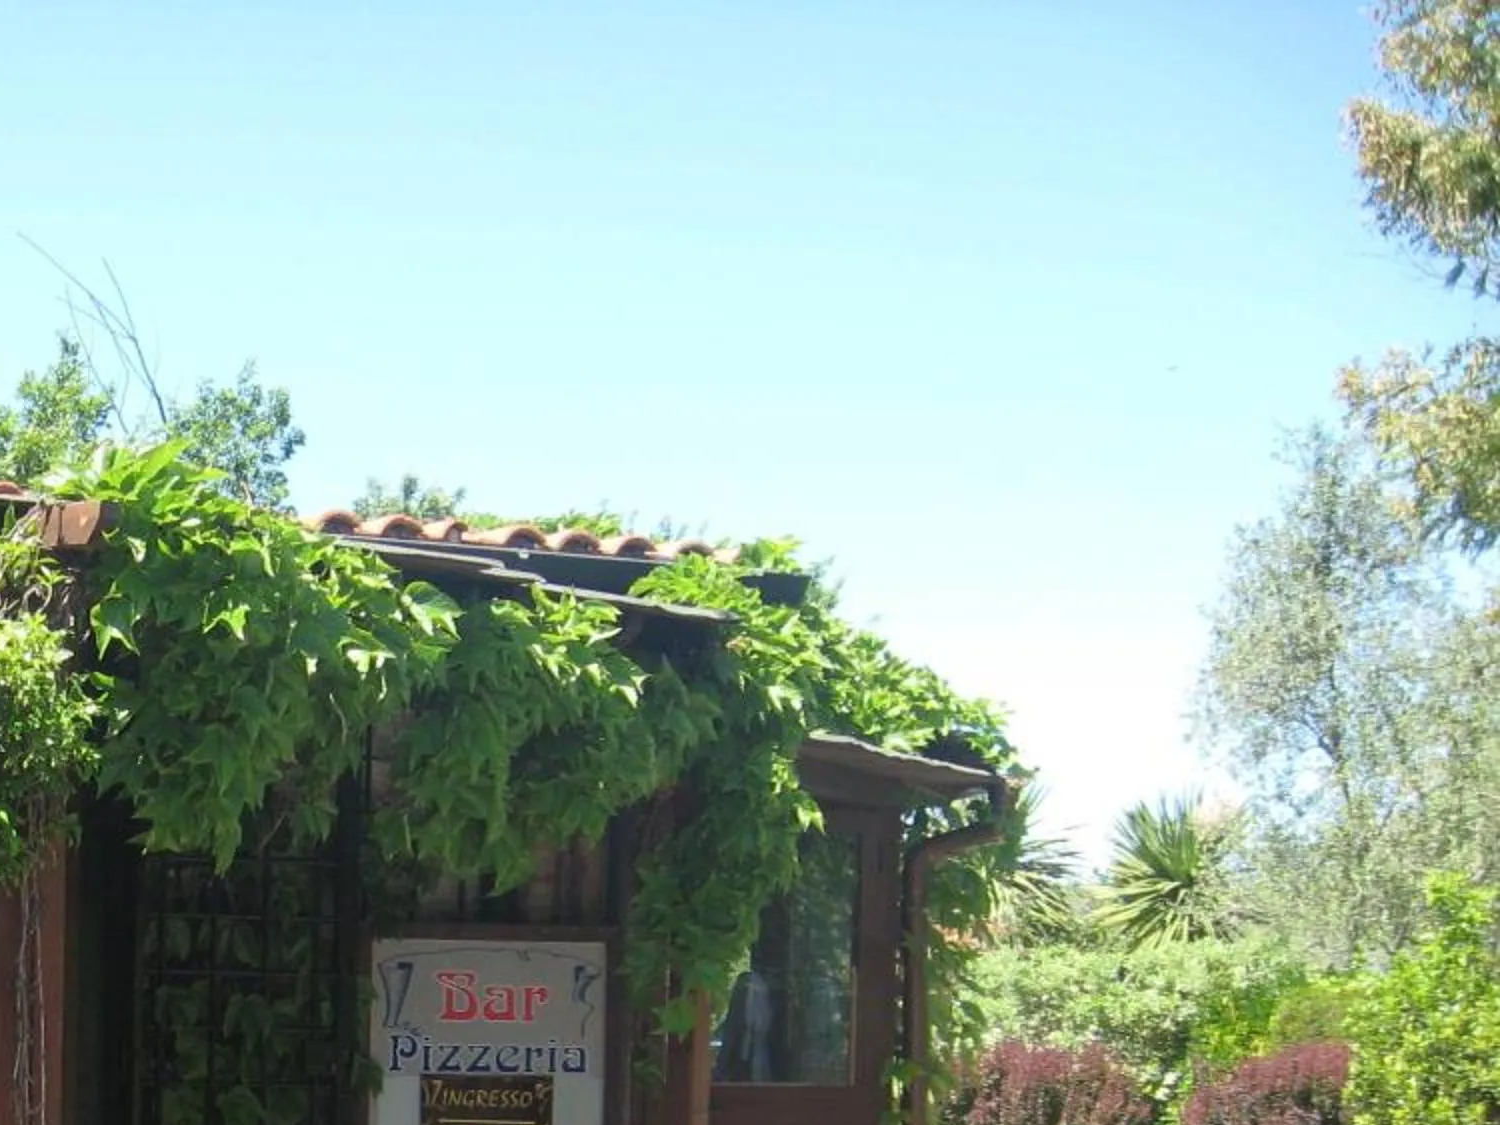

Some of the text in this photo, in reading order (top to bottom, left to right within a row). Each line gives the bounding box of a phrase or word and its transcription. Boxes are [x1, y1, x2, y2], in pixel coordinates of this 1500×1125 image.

[436, 971, 549, 1022] Bar
[389, 1034, 587, 1073] Pizzeria
[442, 1087, 533, 1107] INGRESSO
